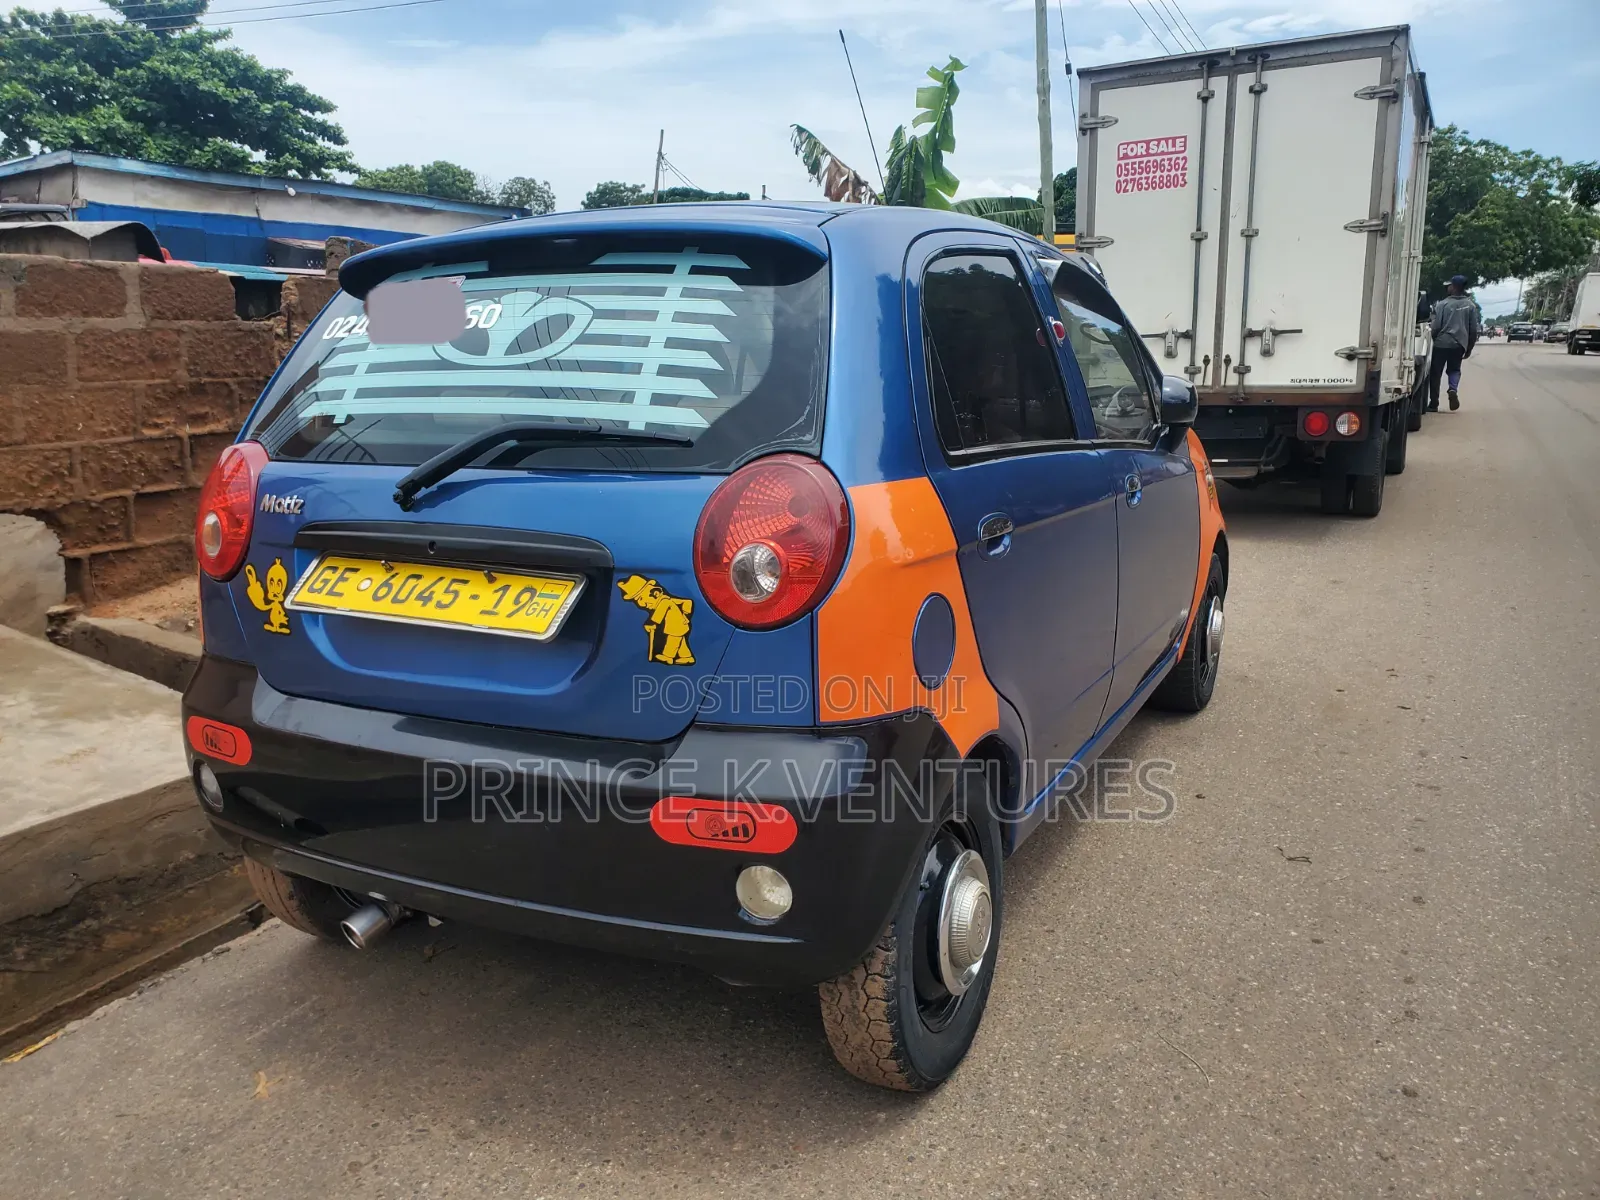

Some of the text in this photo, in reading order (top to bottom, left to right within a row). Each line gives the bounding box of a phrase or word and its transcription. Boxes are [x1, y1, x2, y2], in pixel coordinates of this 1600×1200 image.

[1119, 138, 1185, 157] FOR SALE
[1116, 157, 1188, 178] 0555696362
[1115, 173, 1187, 194] 0276368803
[259, 493, 305, 515] Matiz
[307, 564, 361, 598] GE
[525, 601, 555, 619] GH
